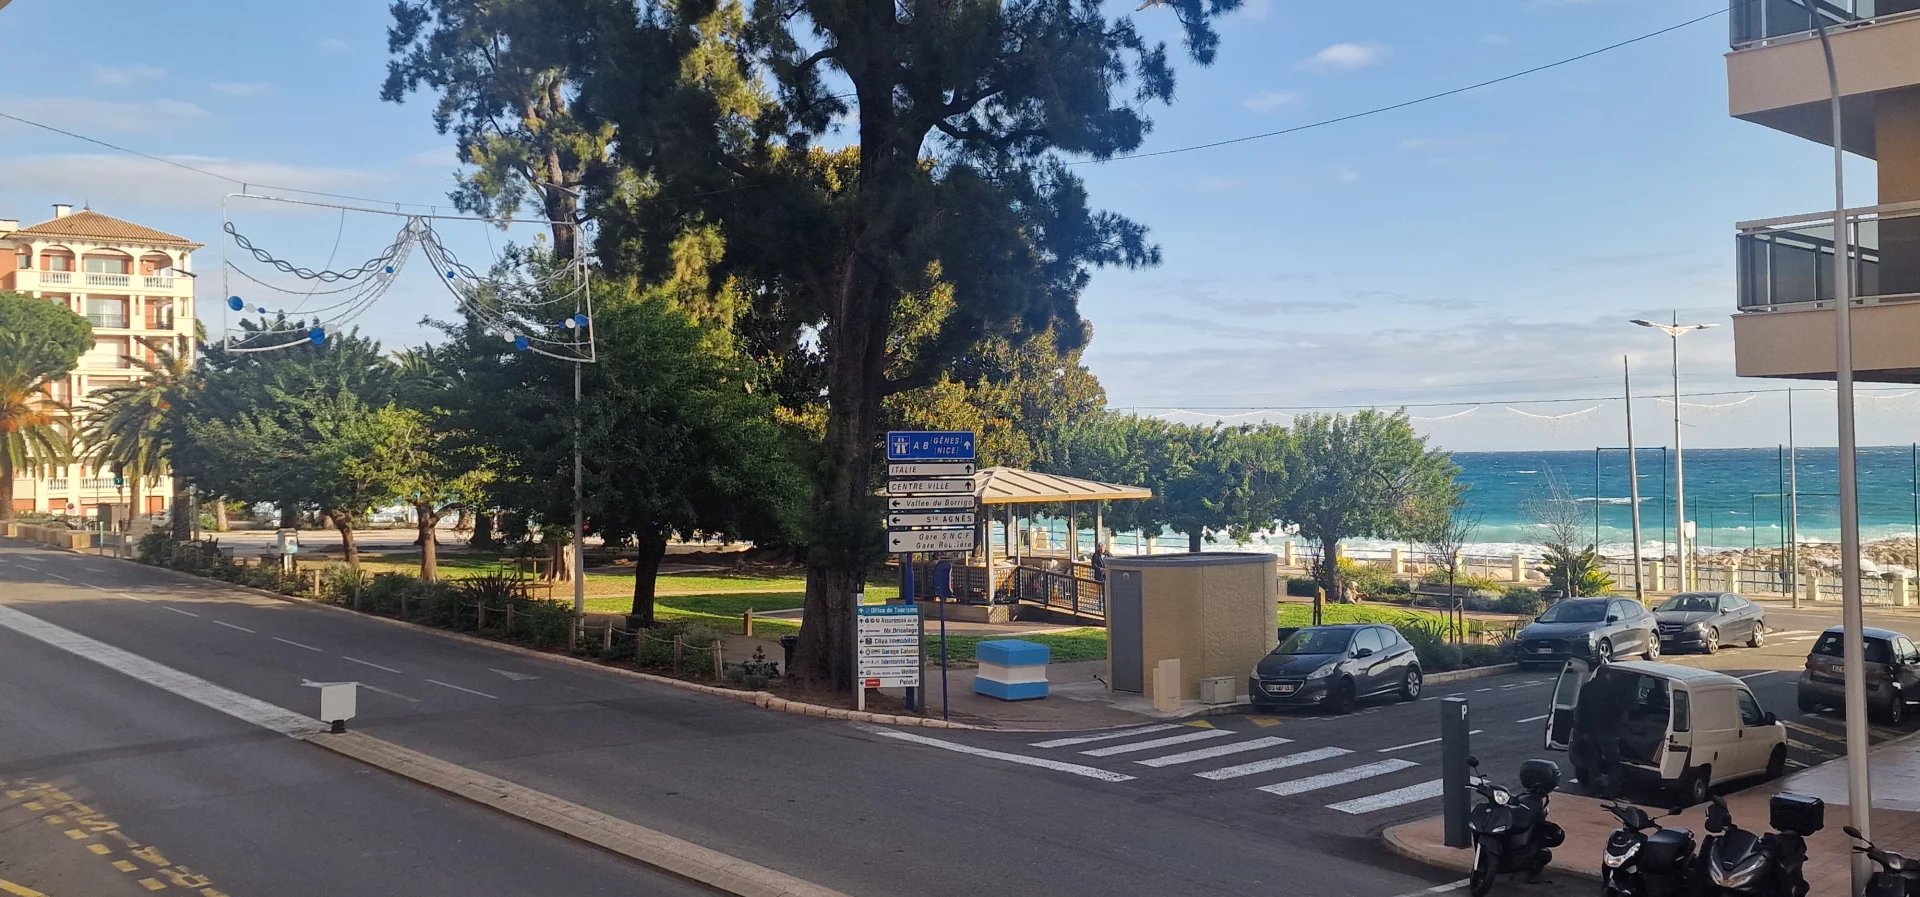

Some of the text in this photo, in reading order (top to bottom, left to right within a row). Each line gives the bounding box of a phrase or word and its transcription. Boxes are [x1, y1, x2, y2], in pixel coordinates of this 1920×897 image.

[912, 441, 920, 450] A
[891, 465, 917, 474] ITALIE
[891, 482, 950, 491] CENTRE VILLE
[933, 499, 942, 507] du
[944, 498, 972, 508] Borrigo
[918, 533, 938, 541] Gare
[915, 542, 935, 550] Gare
[1461, 704, 1468, 720] P
